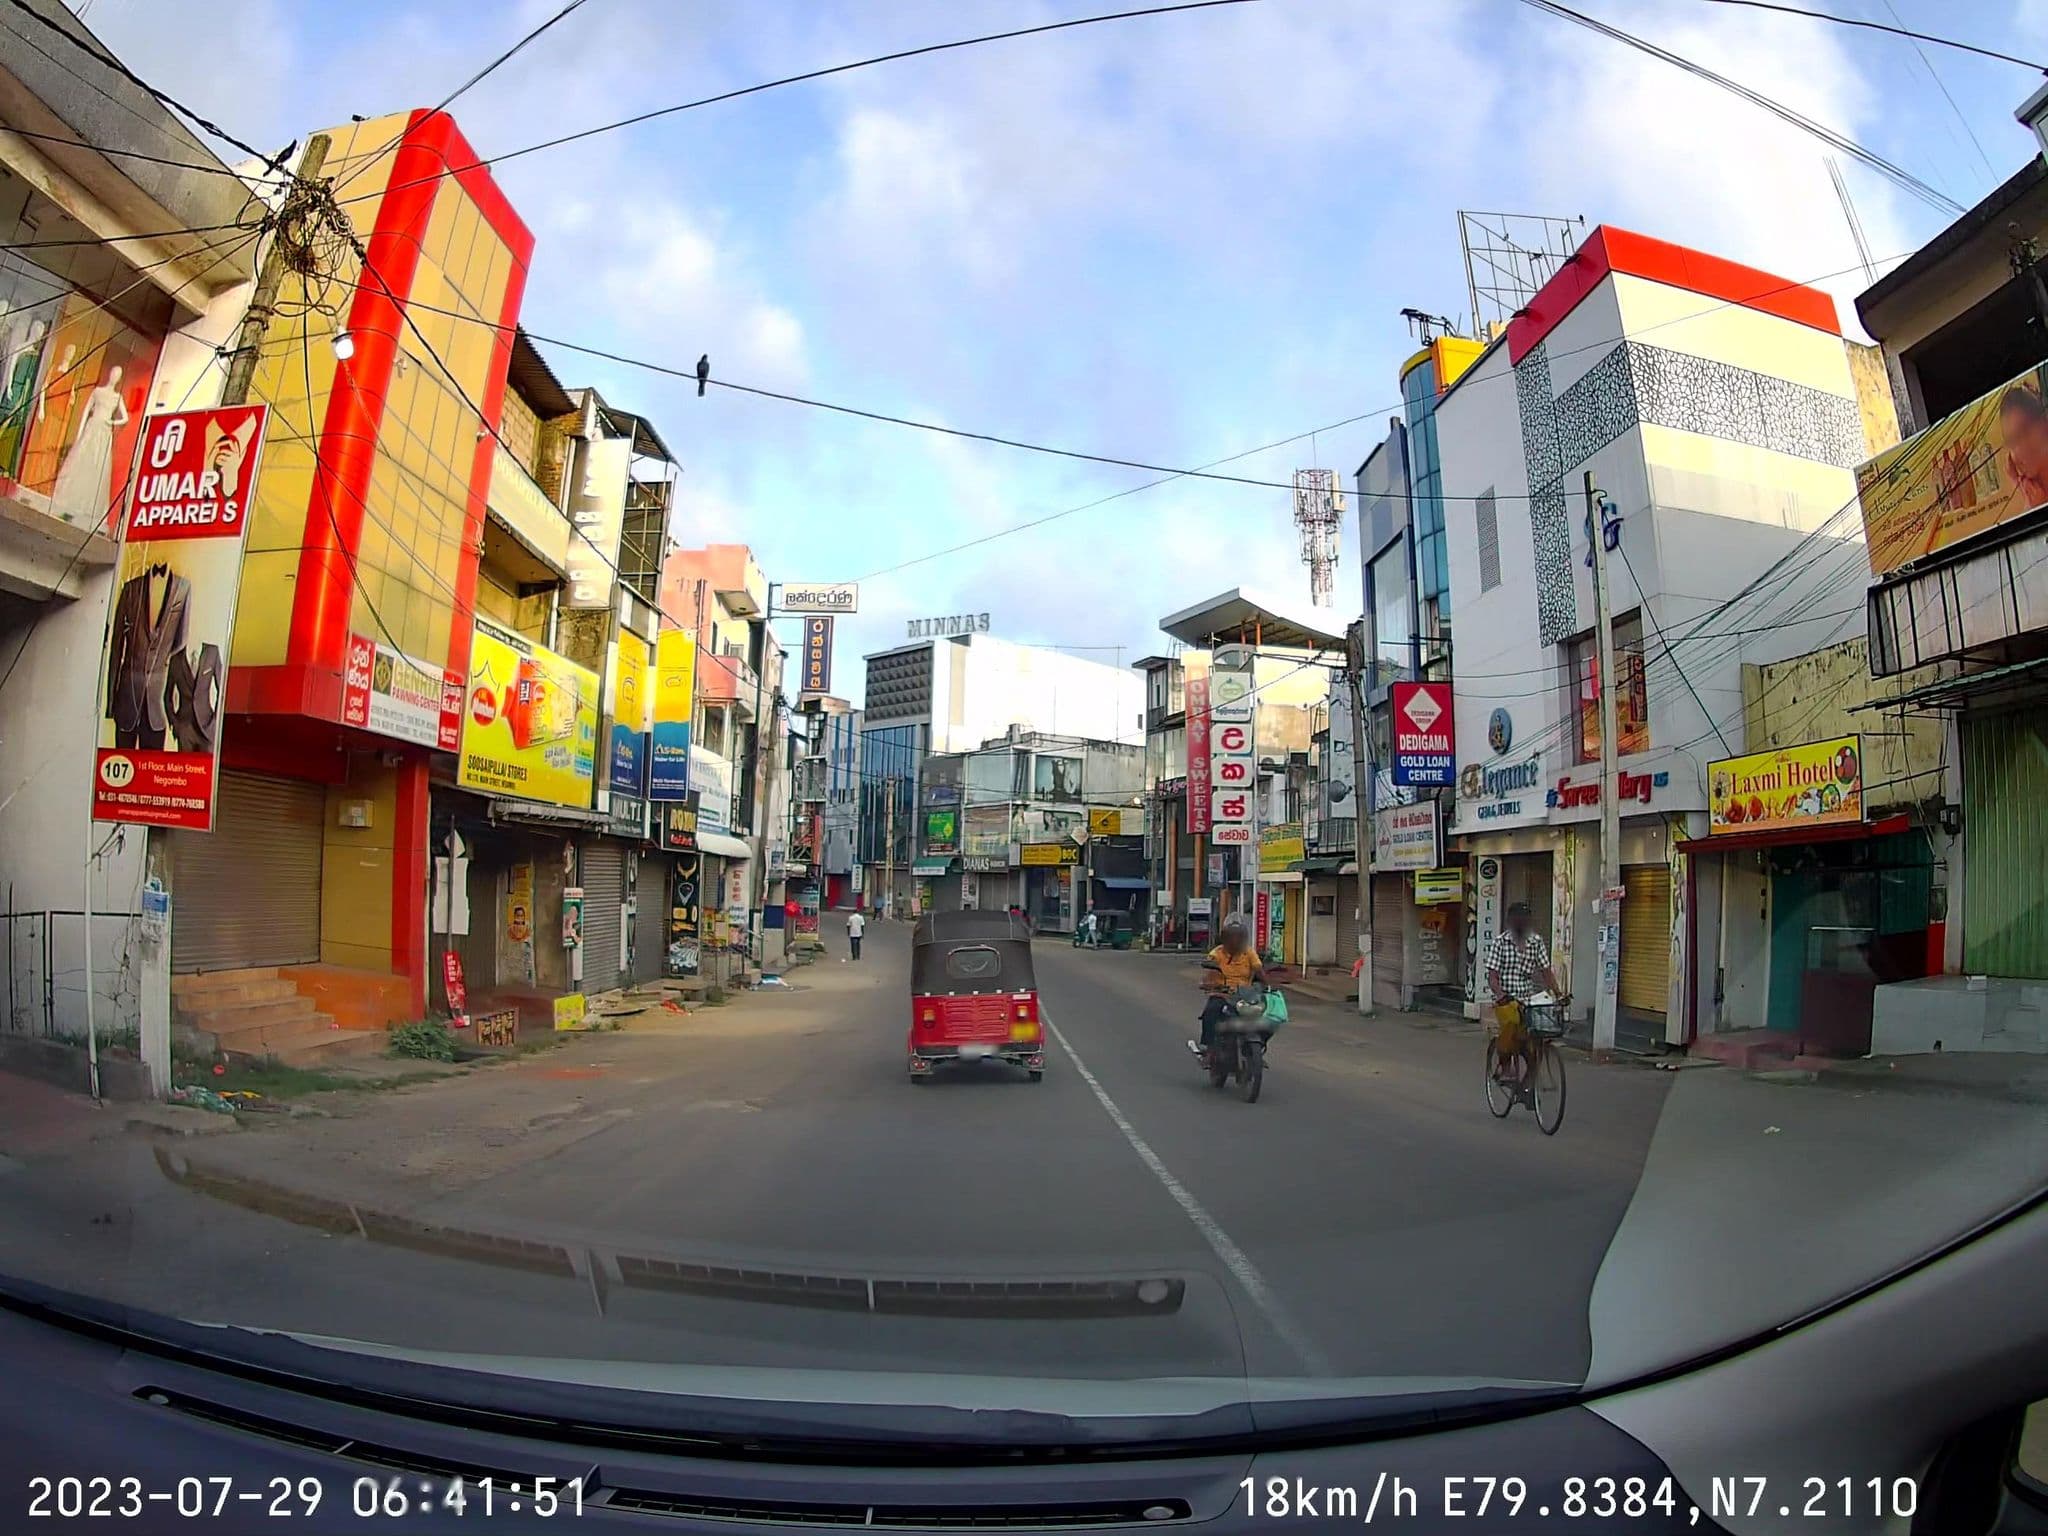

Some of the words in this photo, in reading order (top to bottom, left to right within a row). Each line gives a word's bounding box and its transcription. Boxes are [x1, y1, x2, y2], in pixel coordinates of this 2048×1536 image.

[138, 471, 219, 503] UMAR
[907, 613, 990, 639] MINNAS
[1190, 664, 1206, 743] OMBAY
[1399, 734, 1449, 752] DEDIGAMA
[105, 763, 129, 779] 107
[138, 761, 147, 771] 1st
[167, 762, 184, 772] Main
[1400, 756, 1425, 768] GOLD
[1427, 756, 1450, 768] LOAN
[153, 774, 187, 787] Negombo
[508, 764, 528, 782] STORES
[1408, 769, 1444, 781] CENTRE
[1731, 764, 1781, 795] Laxmi
[1787, 756, 1835, 787] Hotel
[1190, 757, 1208, 832] SWEETS
